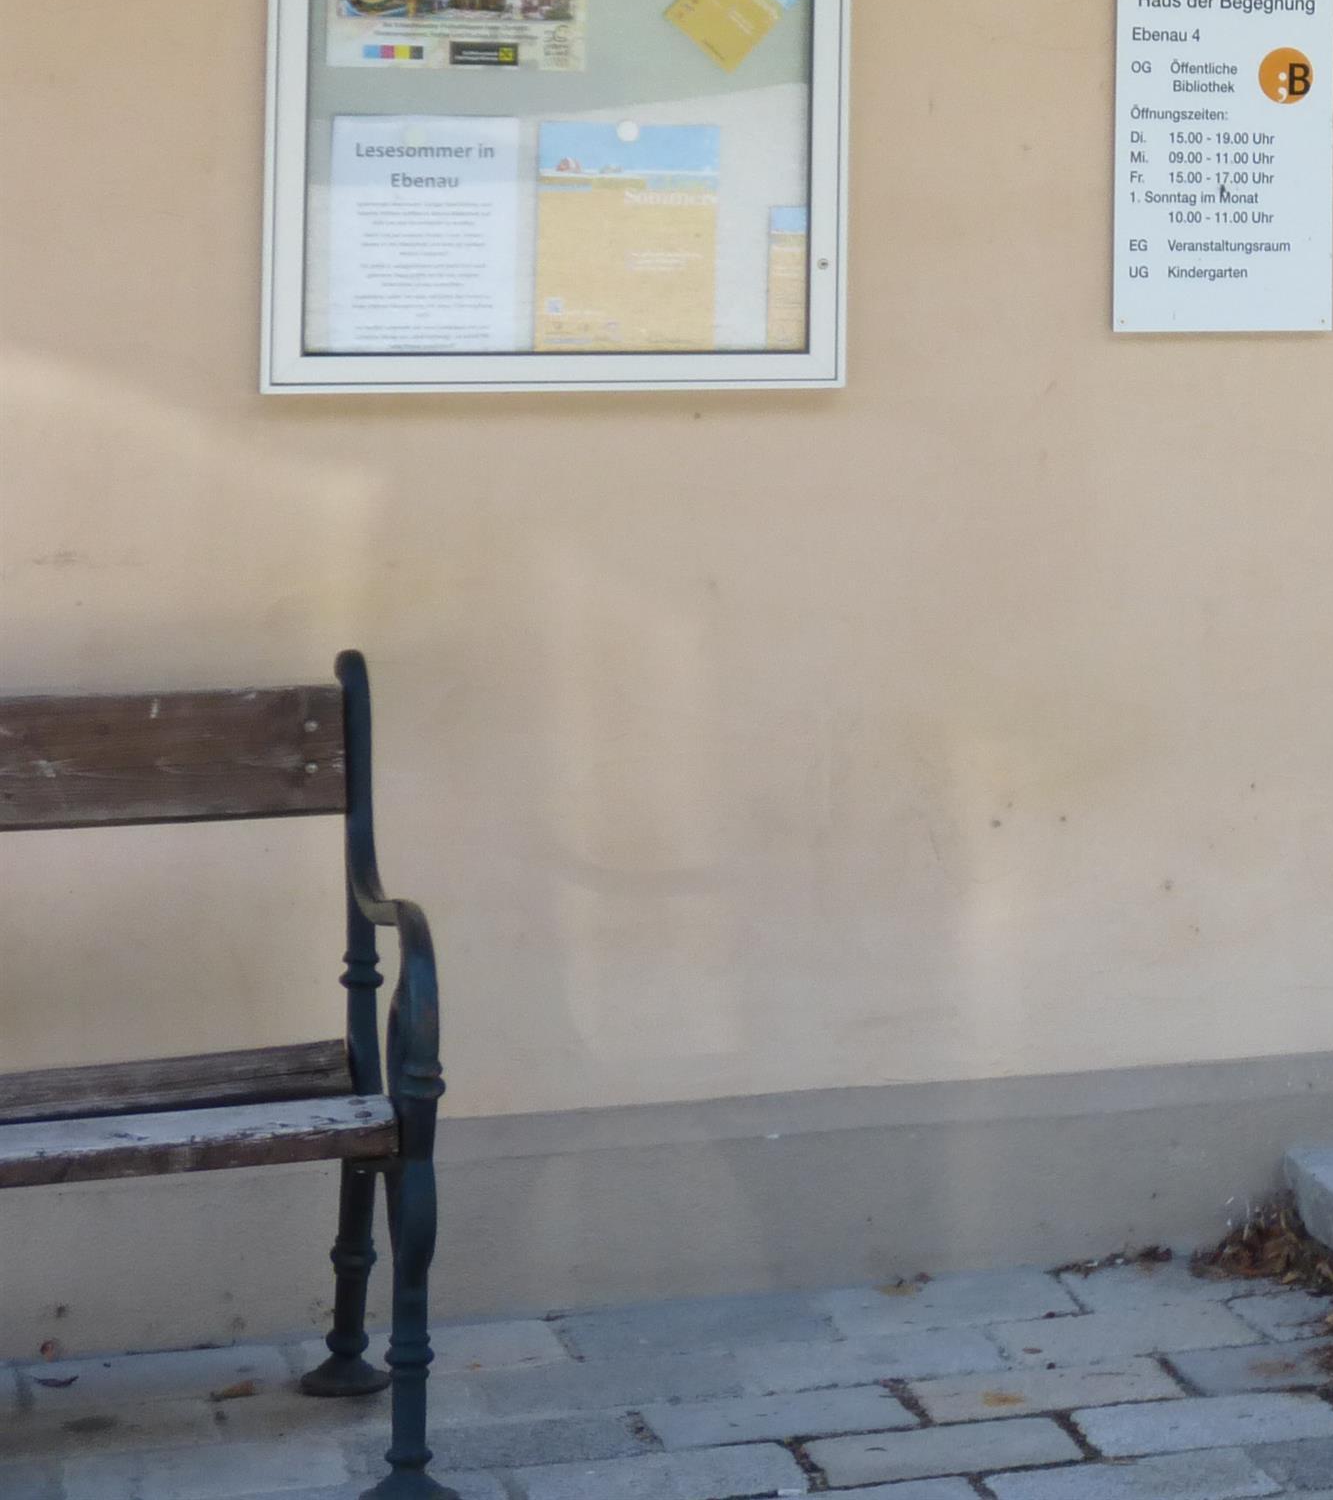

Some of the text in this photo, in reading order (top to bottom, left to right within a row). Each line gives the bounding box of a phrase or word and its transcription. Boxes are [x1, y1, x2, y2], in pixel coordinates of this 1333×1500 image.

[1132, 27, 1200, 42] Ebenau 4
[1131, 59, 1238, 75] OG Öffentliche
[1173, 80, 1236, 93] Bibliothek
[1130, 104, 1229, 122] Öffnungszeiten:
[1130, 131, 1146, 144] Di.
[1168, 132, 1203, 144] 15.00
[1216, 132, 1249, 145] 19.00
[1252, 133, 1275, 145] Uhr
[355, 142, 495, 159] Lesesommer in
[1130, 151, 1148, 164] Mi.
[1168, 152, 1203, 164] 09.00
[1216, 152, 1249, 165] 11.00
[1252, 153, 1275, 165] Uhr
[390, 172, 459, 188] Ebenau
[1130, 171, 1145, 184] Fr.
[1168, 172, 1203, 184] 15.00
[1216, 172, 1249, 185] 17.00
[1252, 173, 1275, 185] Uhr
[1130, 190, 1259, 206] 1. Sonntag im Monat
[1168, 211, 1201, 223] 10.00
[1215, 212, 1248, 224] 11.00
[1252, 212, 1274, 224] Uhr
[1129, 239, 1291, 254] EG Veranstaltungsraum
[1129, 266, 1248, 281] UG Kindergarten
